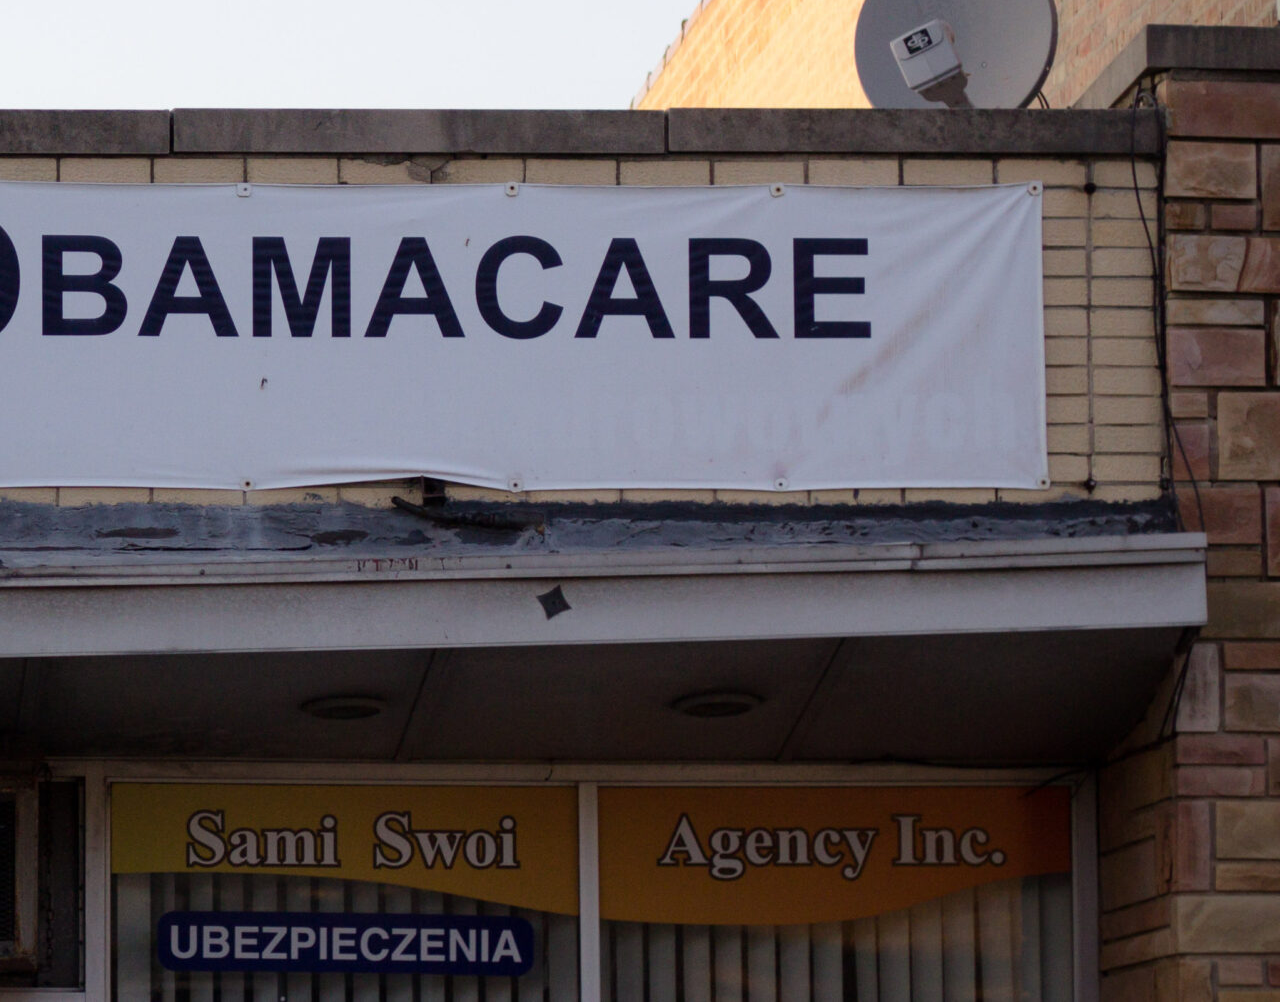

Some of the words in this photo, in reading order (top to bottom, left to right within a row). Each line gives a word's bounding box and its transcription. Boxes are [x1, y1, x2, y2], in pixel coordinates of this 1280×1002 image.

[186, 809, 340, 868] Sami
[373, 810, 521, 870] Swoi
[658, 813, 879, 881] Agency
[892, 814, 1007, 866] Inc.
[169, 924, 523, 964] UBEZPIECZENIA
